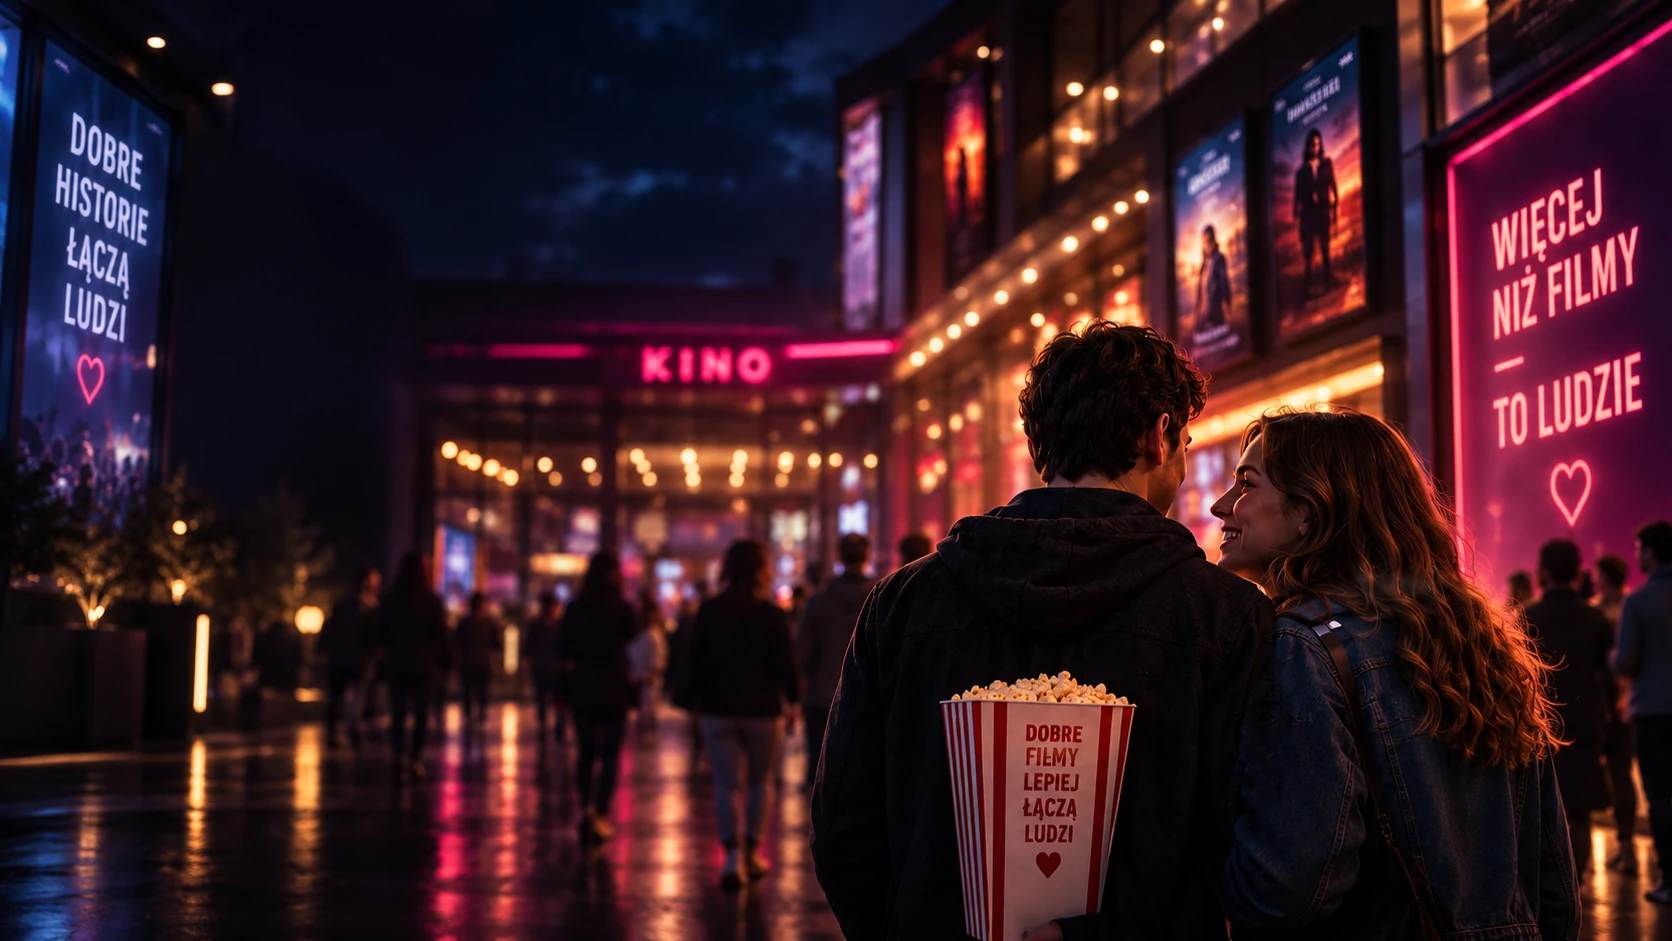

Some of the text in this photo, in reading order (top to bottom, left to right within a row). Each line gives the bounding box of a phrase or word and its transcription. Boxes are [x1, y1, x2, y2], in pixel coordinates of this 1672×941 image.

[70, 112, 143, 191] DOBRE
[55, 163, 149, 246] HISTORIE
[1491, 168, 1603, 271] WIĘCEJ
[66, 227, 130, 300] ŁĄCZĄ
[1493, 226, 1639, 340] NIŻ FILMY
[64, 283, 127, 343] LUDZI
[641, 345, 773, 384] KINO
[1493, 352, 1643, 449] TO LUDZIE
[1025, 724, 1083, 743] DOBRE
[1022, 797, 1077, 821] ŁĄCZĄ
[1023, 772, 1080, 792] LEPIEJ
[1024, 824, 1073, 843] LUDZI
